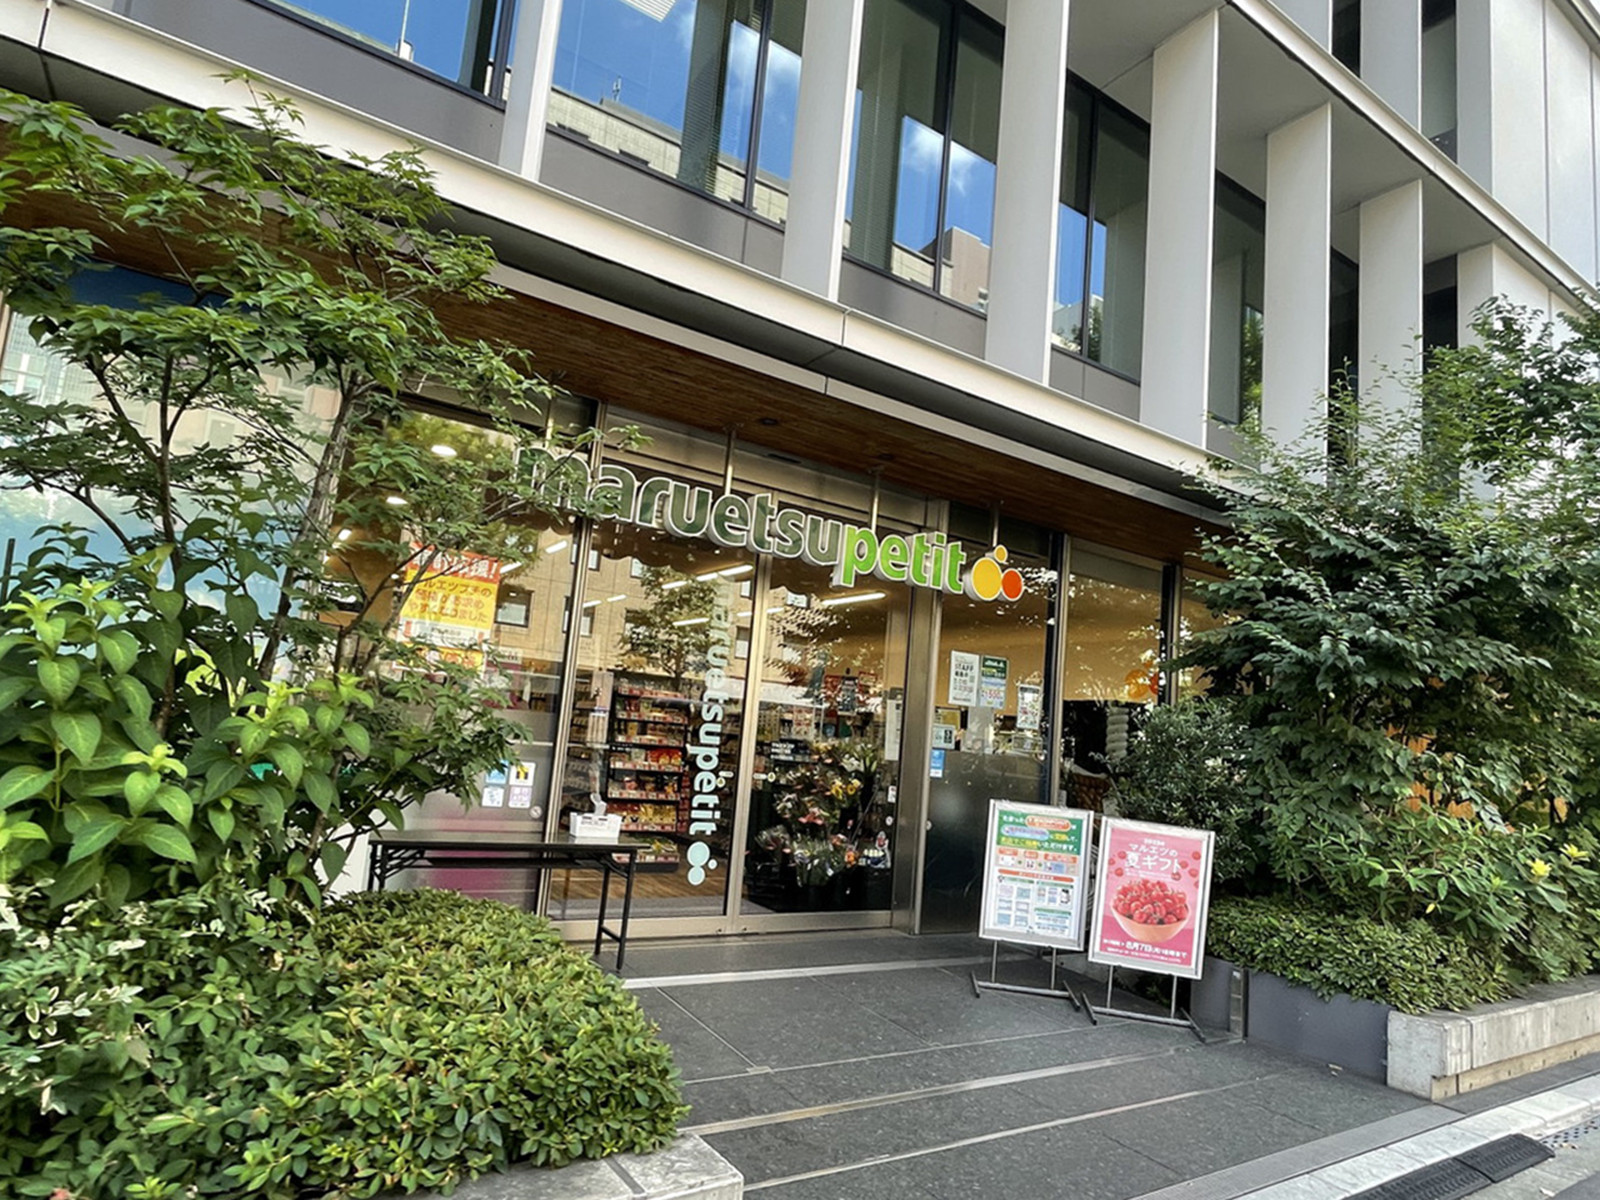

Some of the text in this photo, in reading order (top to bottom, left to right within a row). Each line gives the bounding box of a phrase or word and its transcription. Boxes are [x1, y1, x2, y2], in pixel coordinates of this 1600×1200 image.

[1128, 842, 1179, 858] マルエツの
[1125, 851, 1181, 874] 夏ギフト
